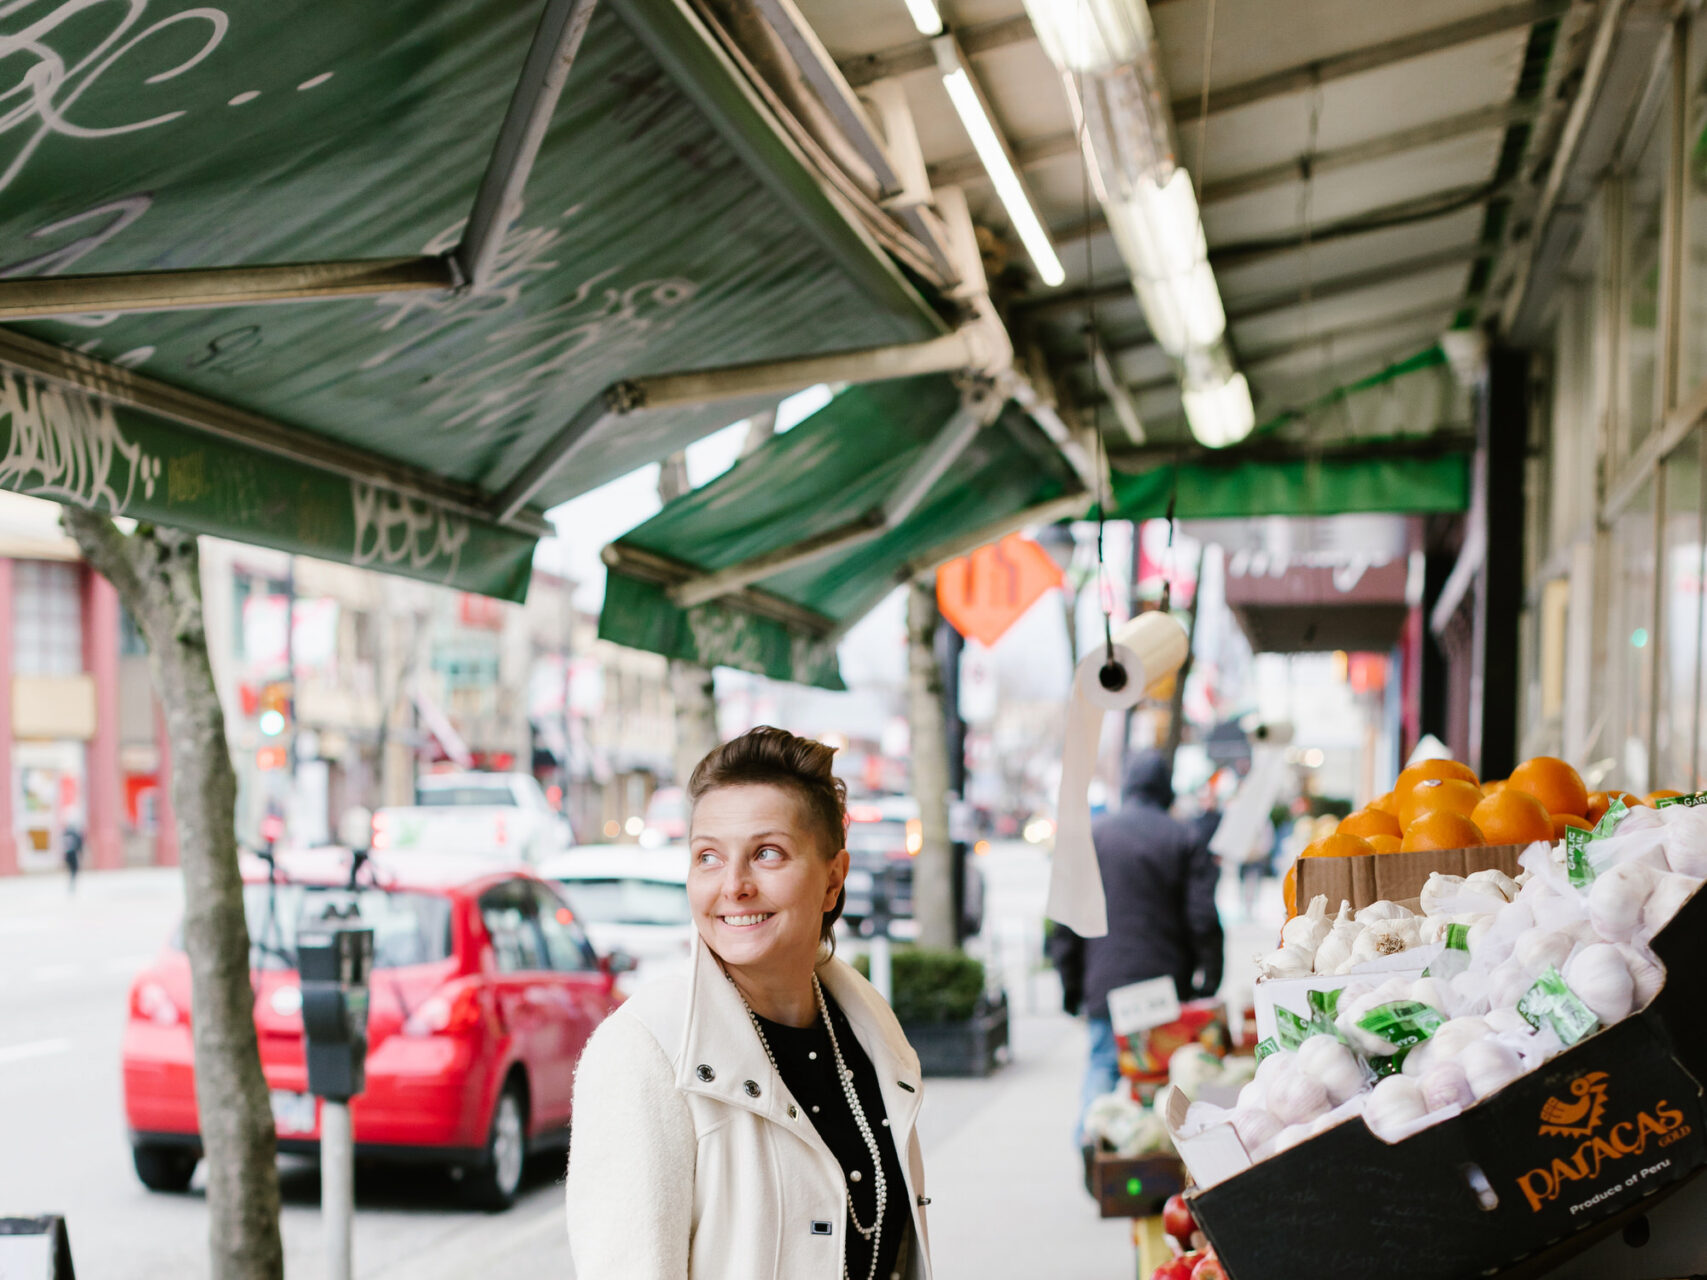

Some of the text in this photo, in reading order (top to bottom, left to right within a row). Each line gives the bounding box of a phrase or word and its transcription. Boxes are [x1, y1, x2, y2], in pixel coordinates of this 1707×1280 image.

[1684, 795, 1707, 807] GAR
[1568, 832, 1576, 870] GARLIC
[1576, 834, 1584, 852] AIL
[1658, 1125, 1692, 1147] GOLD
[1569, 1158, 1671, 1215] Produce of Peru
